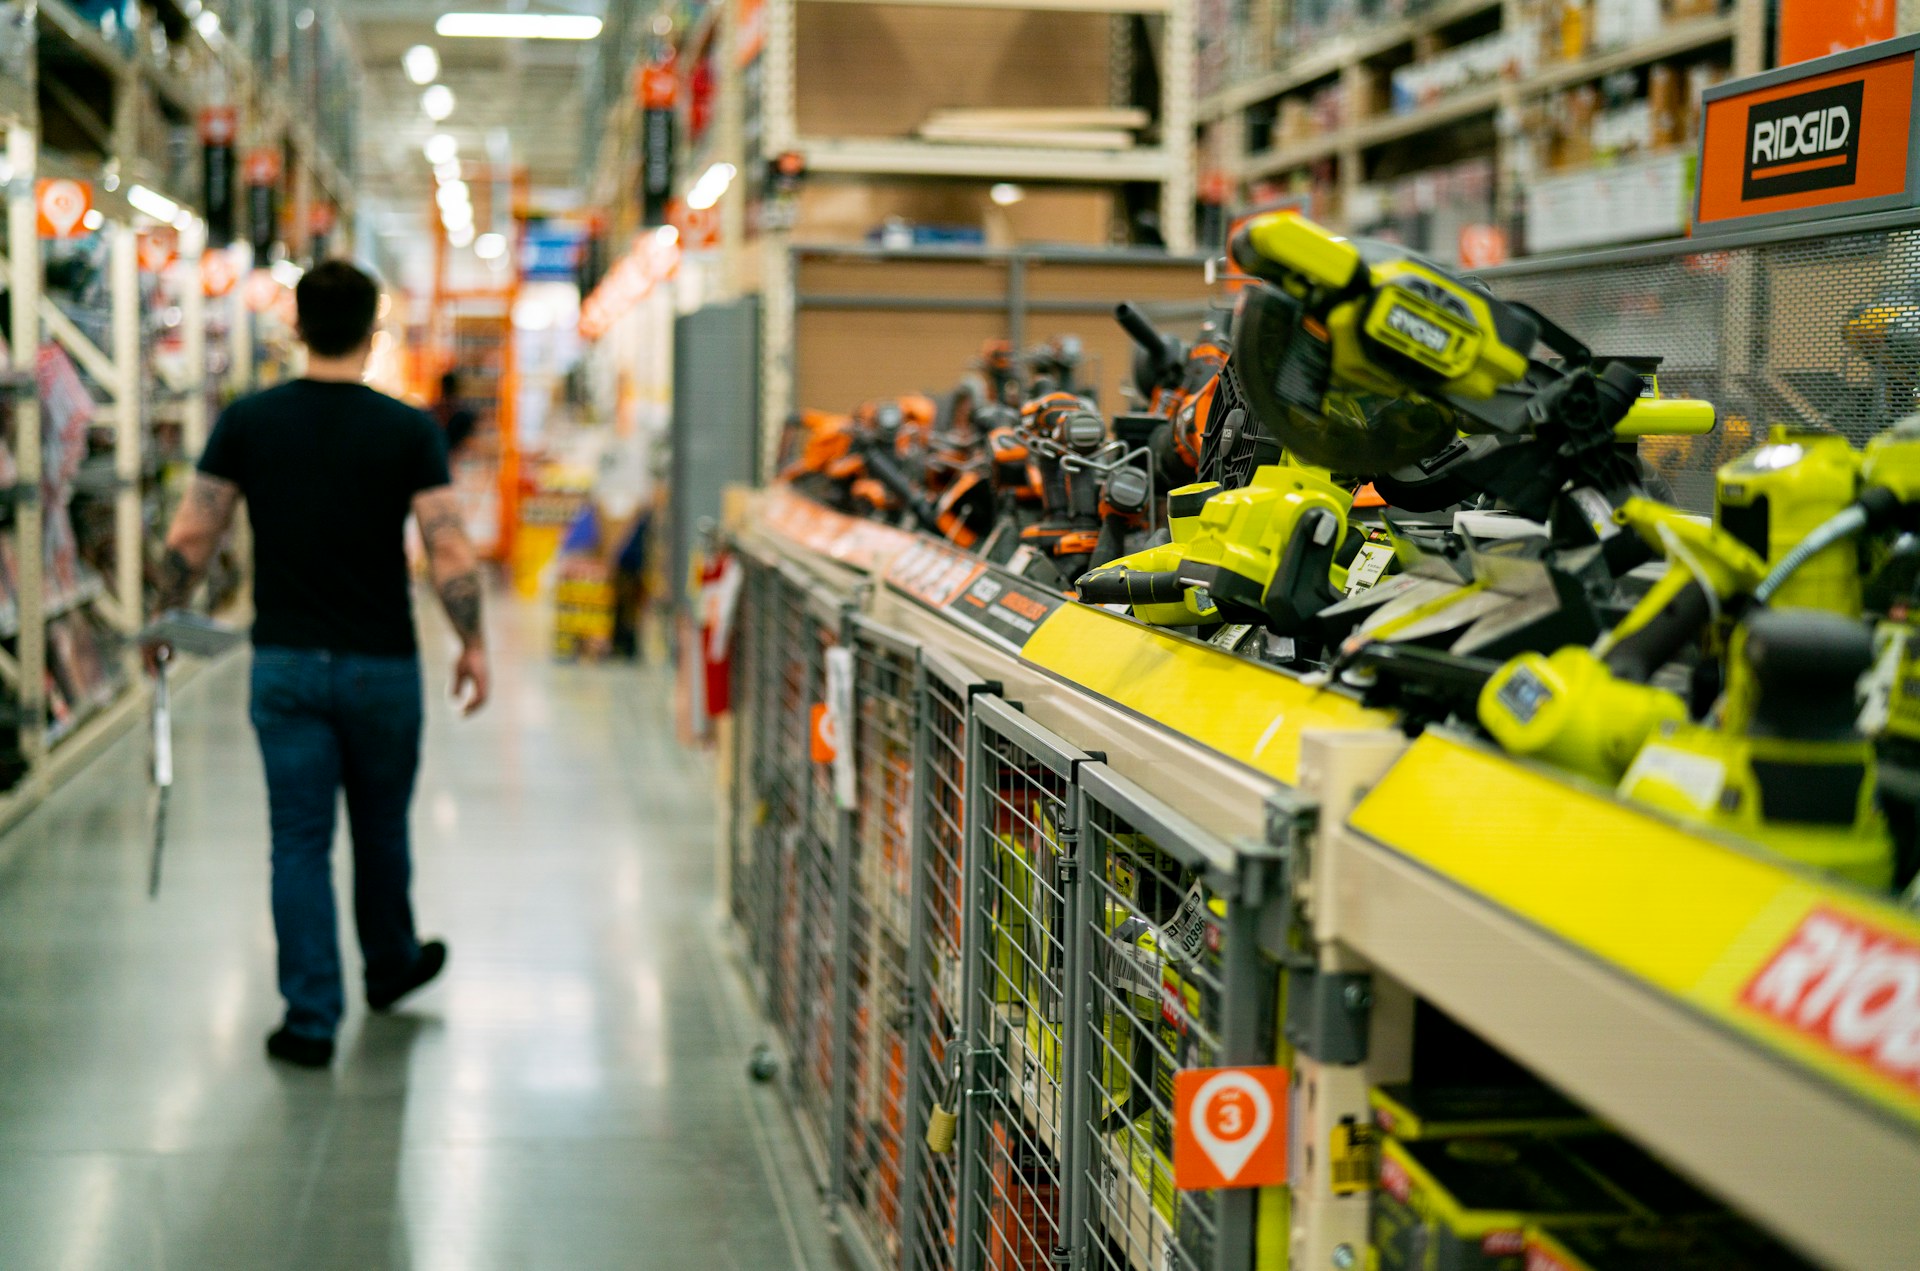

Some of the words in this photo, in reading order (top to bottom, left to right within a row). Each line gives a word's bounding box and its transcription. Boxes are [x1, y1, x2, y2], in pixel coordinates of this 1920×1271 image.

[1752, 105, 1850, 164] RIDGID
[1387, 304, 1451, 353] RYOBI
[1219, 1103, 1242, 1134] 3
